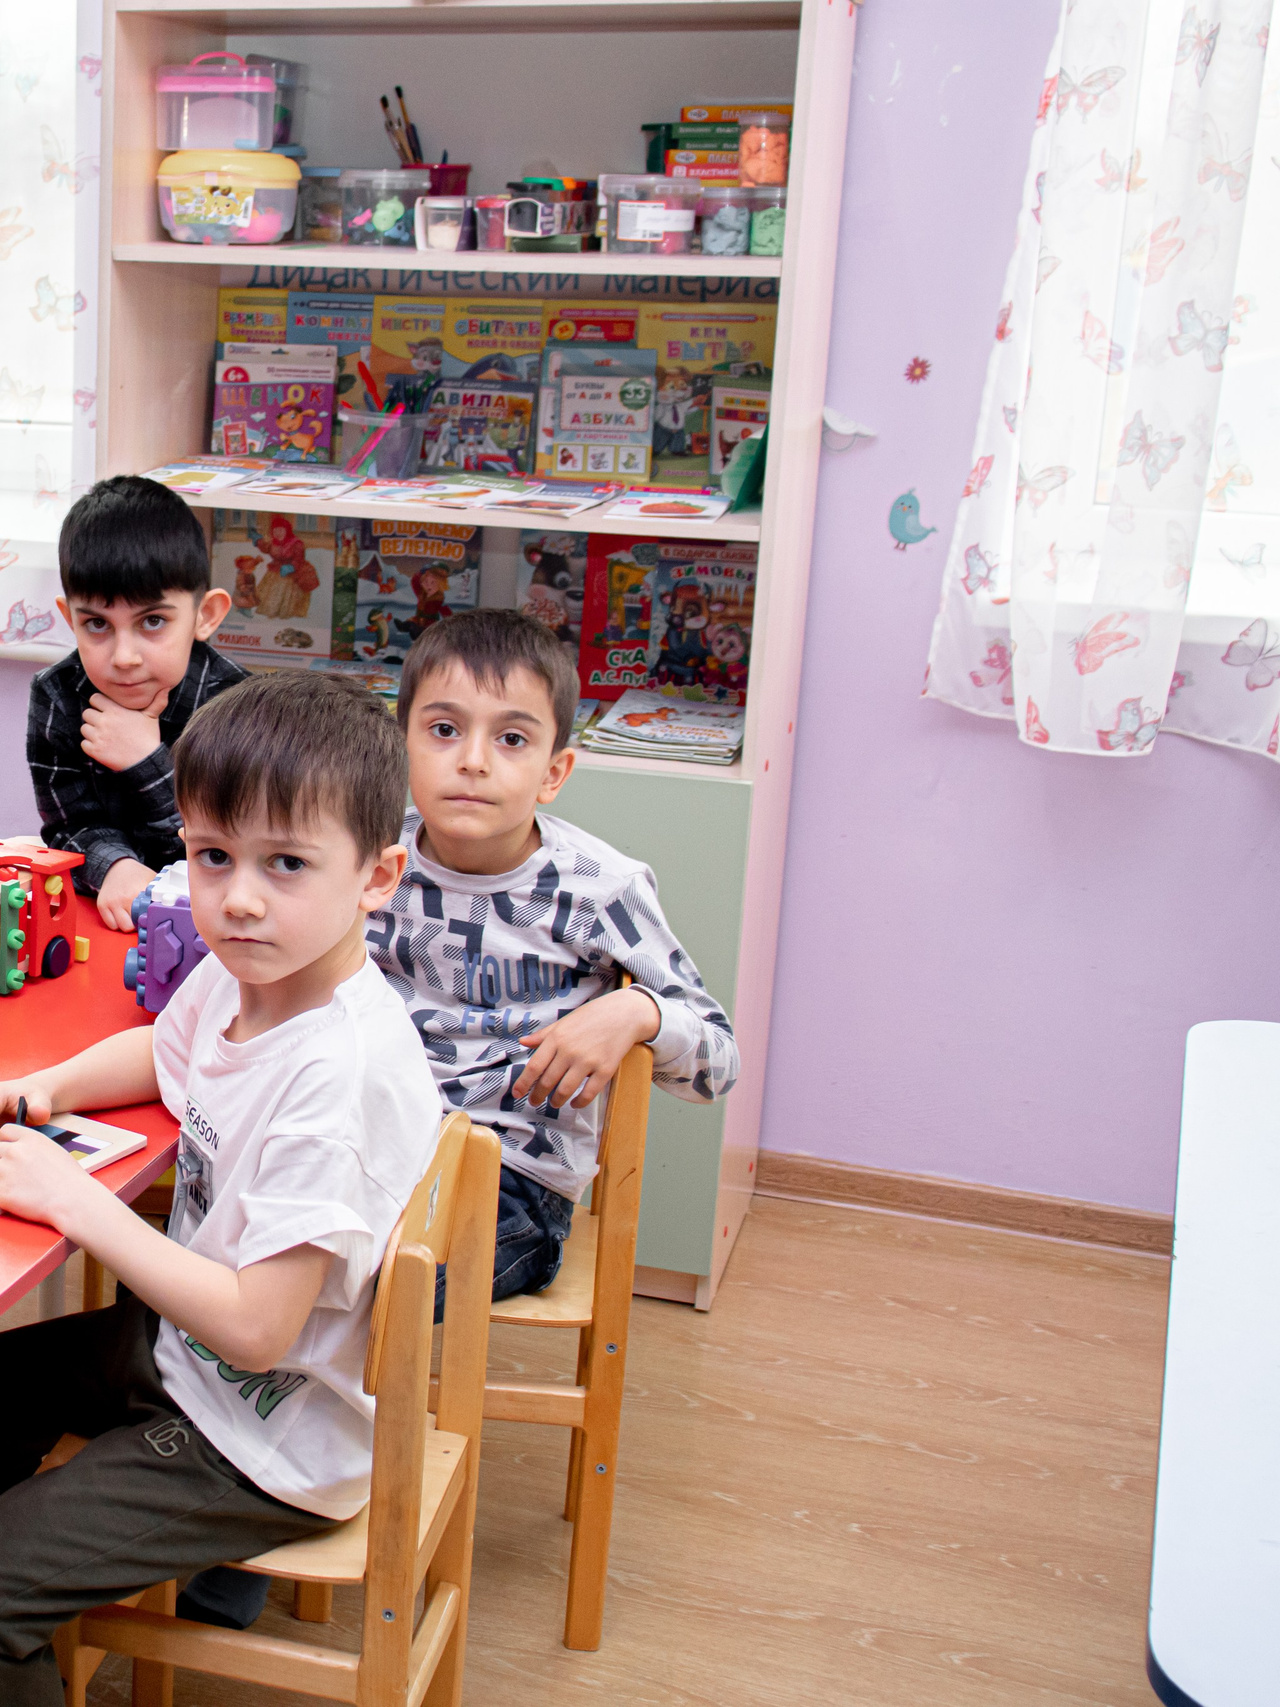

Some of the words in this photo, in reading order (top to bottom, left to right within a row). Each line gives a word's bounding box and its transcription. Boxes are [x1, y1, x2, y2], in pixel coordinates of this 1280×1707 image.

[689, 327, 728, 339] КЕМ
[227, 369, 244, 382] 6+
[221, 384, 324, 409] ЩЕНОК
[626, 384, 646, 398] 33
[571, 412, 635, 426] АЗБУКА
[380, 538, 465, 561] ВЕЛЕНЬЮ
[217, 633, 262, 647] ФИЛИПОК
[185, 1100, 220, 1151] SEASON
